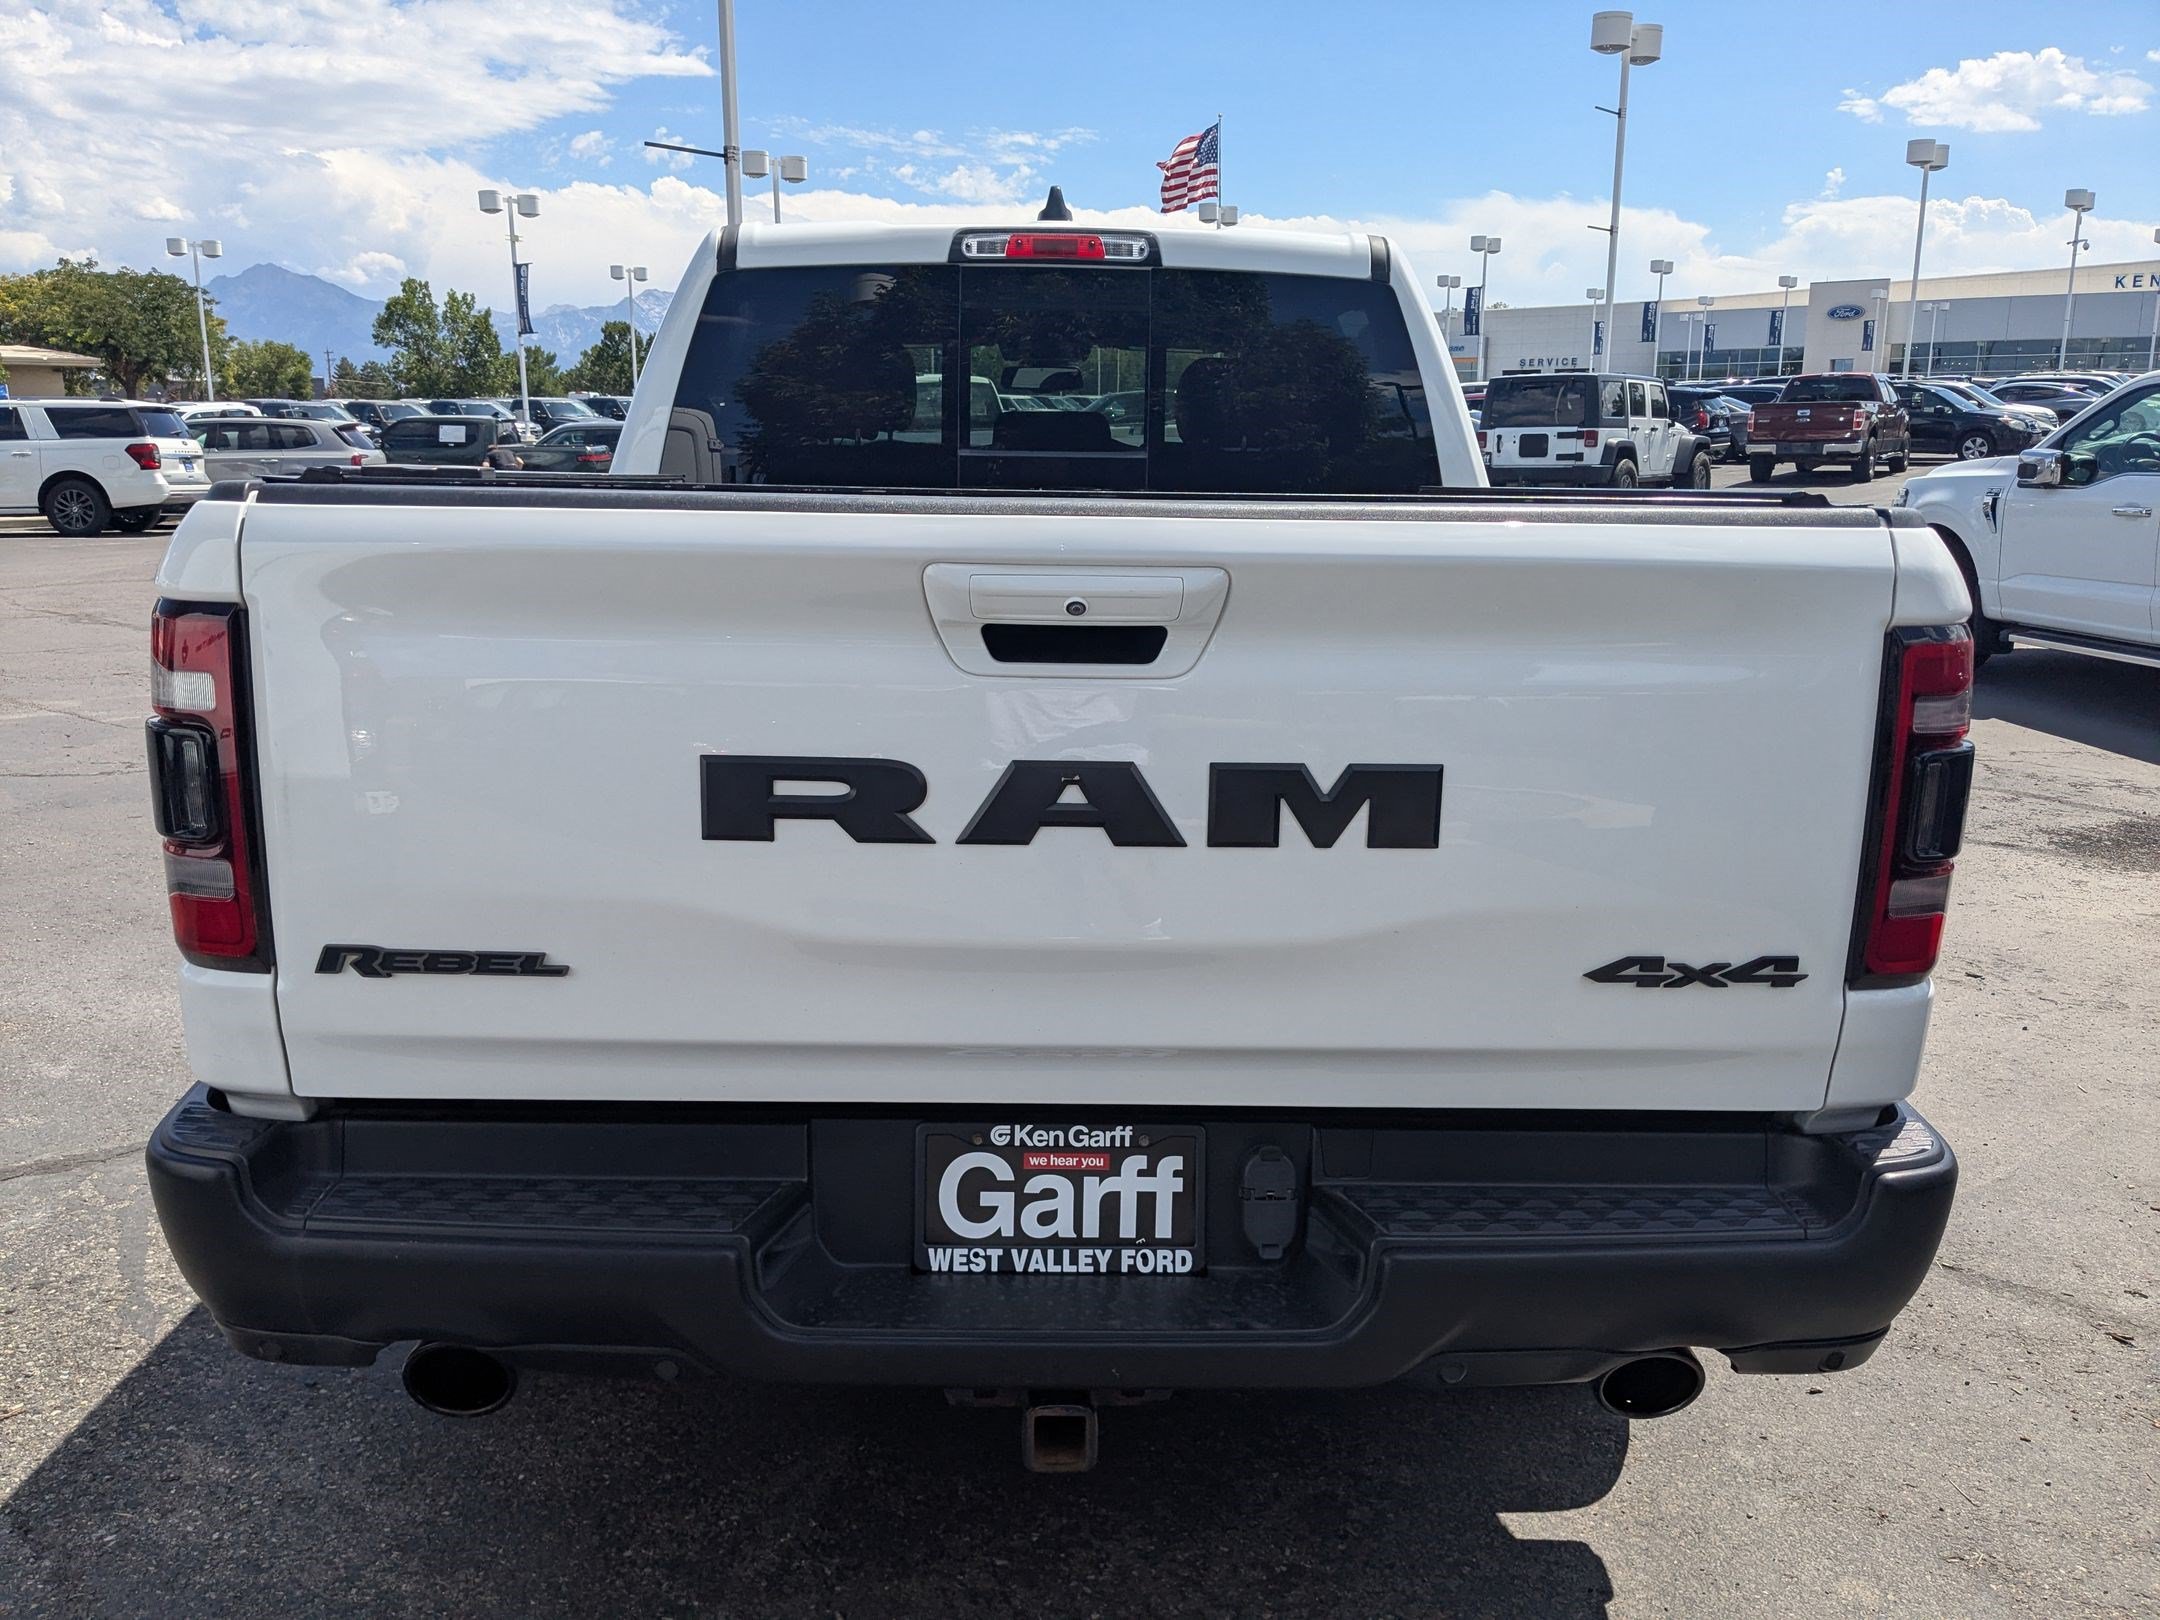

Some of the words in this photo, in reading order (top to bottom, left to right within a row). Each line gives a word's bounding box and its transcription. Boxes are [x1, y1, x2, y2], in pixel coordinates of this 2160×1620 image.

[2115, 274, 2160, 288] KEN
[1520, 357, 1578, 367] SERVICE
[701, 755, 1443, 848] RAM
[315, 944, 569, 978] REBEL
[1014, 1124, 1064, 1147] Ken
[1068, 1125, 1133, 1147] Garff
[1029, 1156, 1047, 1166] we
[1051, 1154, 1078, 1166] hear
[1081, 1157, 1104, 1168] you
[938, 1151, 1184, 1239] Garff
[928, 1248, 1003, 1272] WEST
[1011, 1249, 1112, 1273] VALLEY
[1121, 1249, 1193, 1273] FORD
